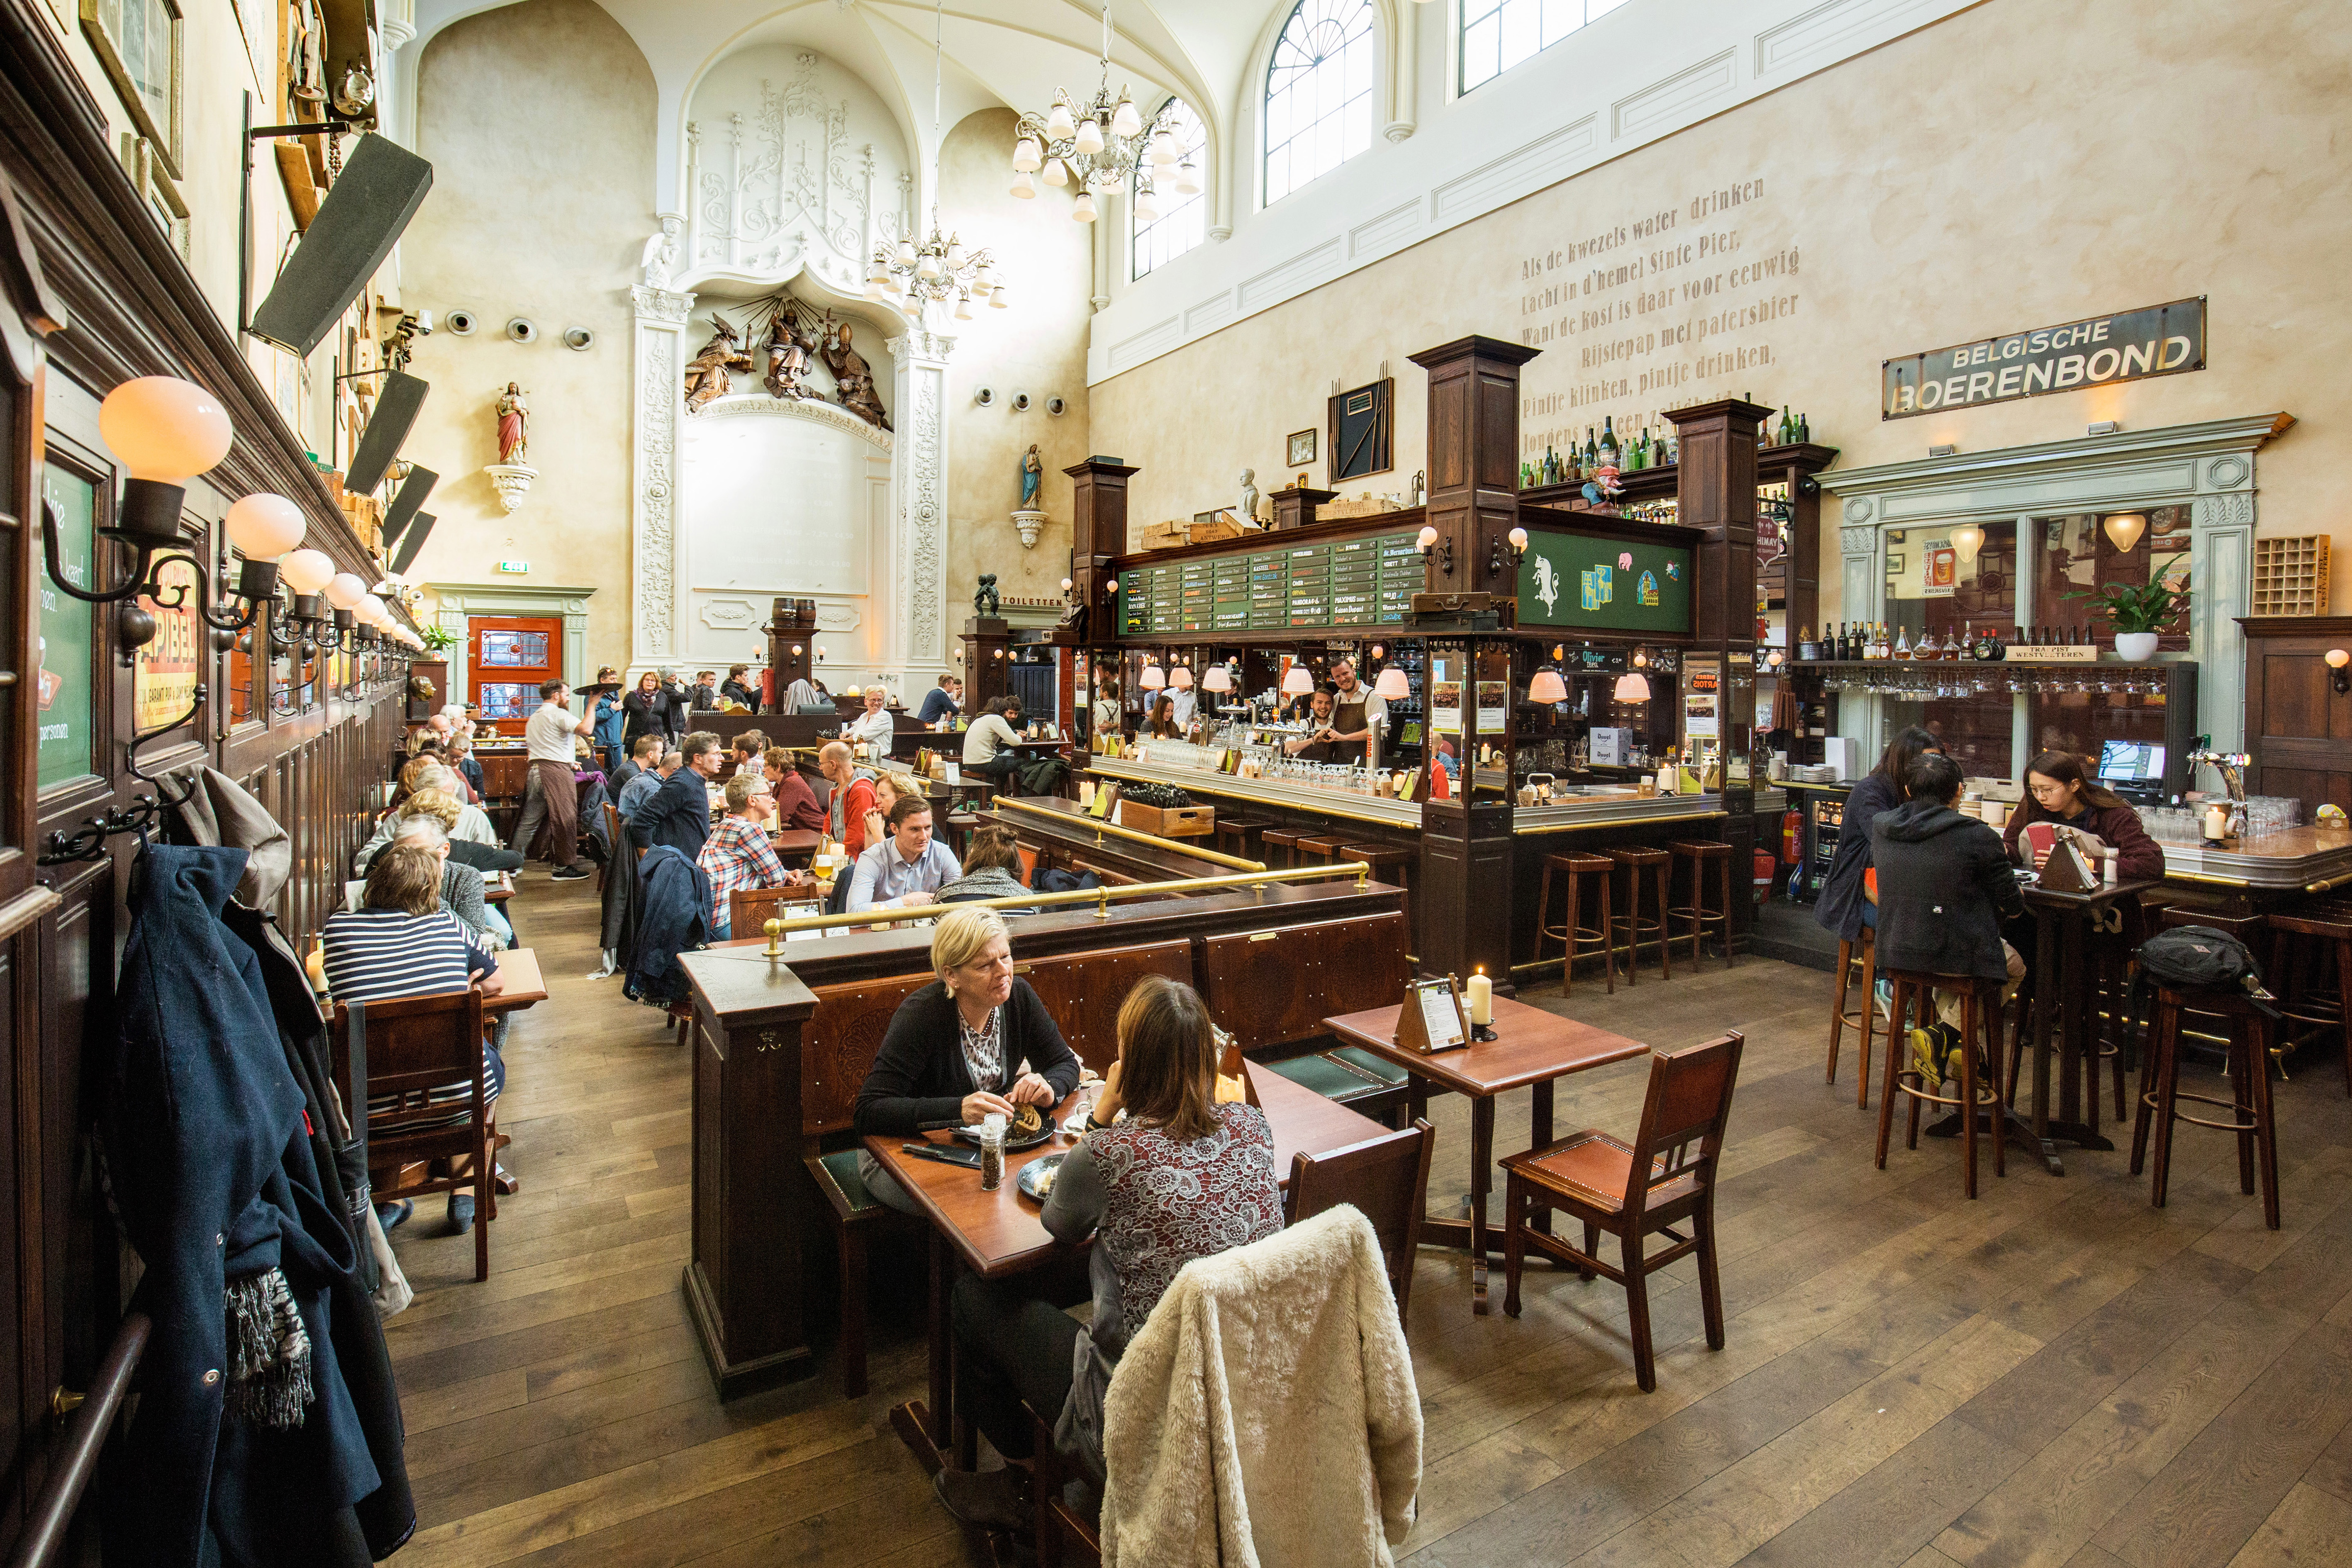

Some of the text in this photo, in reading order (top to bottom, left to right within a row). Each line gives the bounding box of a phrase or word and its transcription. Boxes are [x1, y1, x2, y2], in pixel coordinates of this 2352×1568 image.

[1522, 178, 1764, 280] Als de kwezels water drinken
[1522, 285, 1558, 316] Lacht
[1564, 282, 1577, 302] in
[1650, 243, 1691, 274] Sinte
[1699, 230, 1740, 259] Pier,
[1522, 246, 1799, 346] Want de kost is daar voor eeuwig
[1582, 295, 1799, 368] Rijstepap met patersbier
[1952, 320, 2111, 369] BELGISCHE
[1523, 345, 1776, 419] Pintje klinken, pintje drinken,
[1890, 335, 2191, 415] BOERENBOND
[1523, 426, 1579, 456] Jongens
[1616, 411, 1643, 435] een
[1323, 506, 1376, 516] WESTVLETEREN
[1757, 537, 1778, 547] HIMAY
[66, 548, 84, 587] kaart
[1002, 597, 1062, 606] TOILETTEN
[1582, 650, 1605, 662] Olivier
[149, 687, 164, 703] GARANTI
[39, 723, 69, 749] personen
